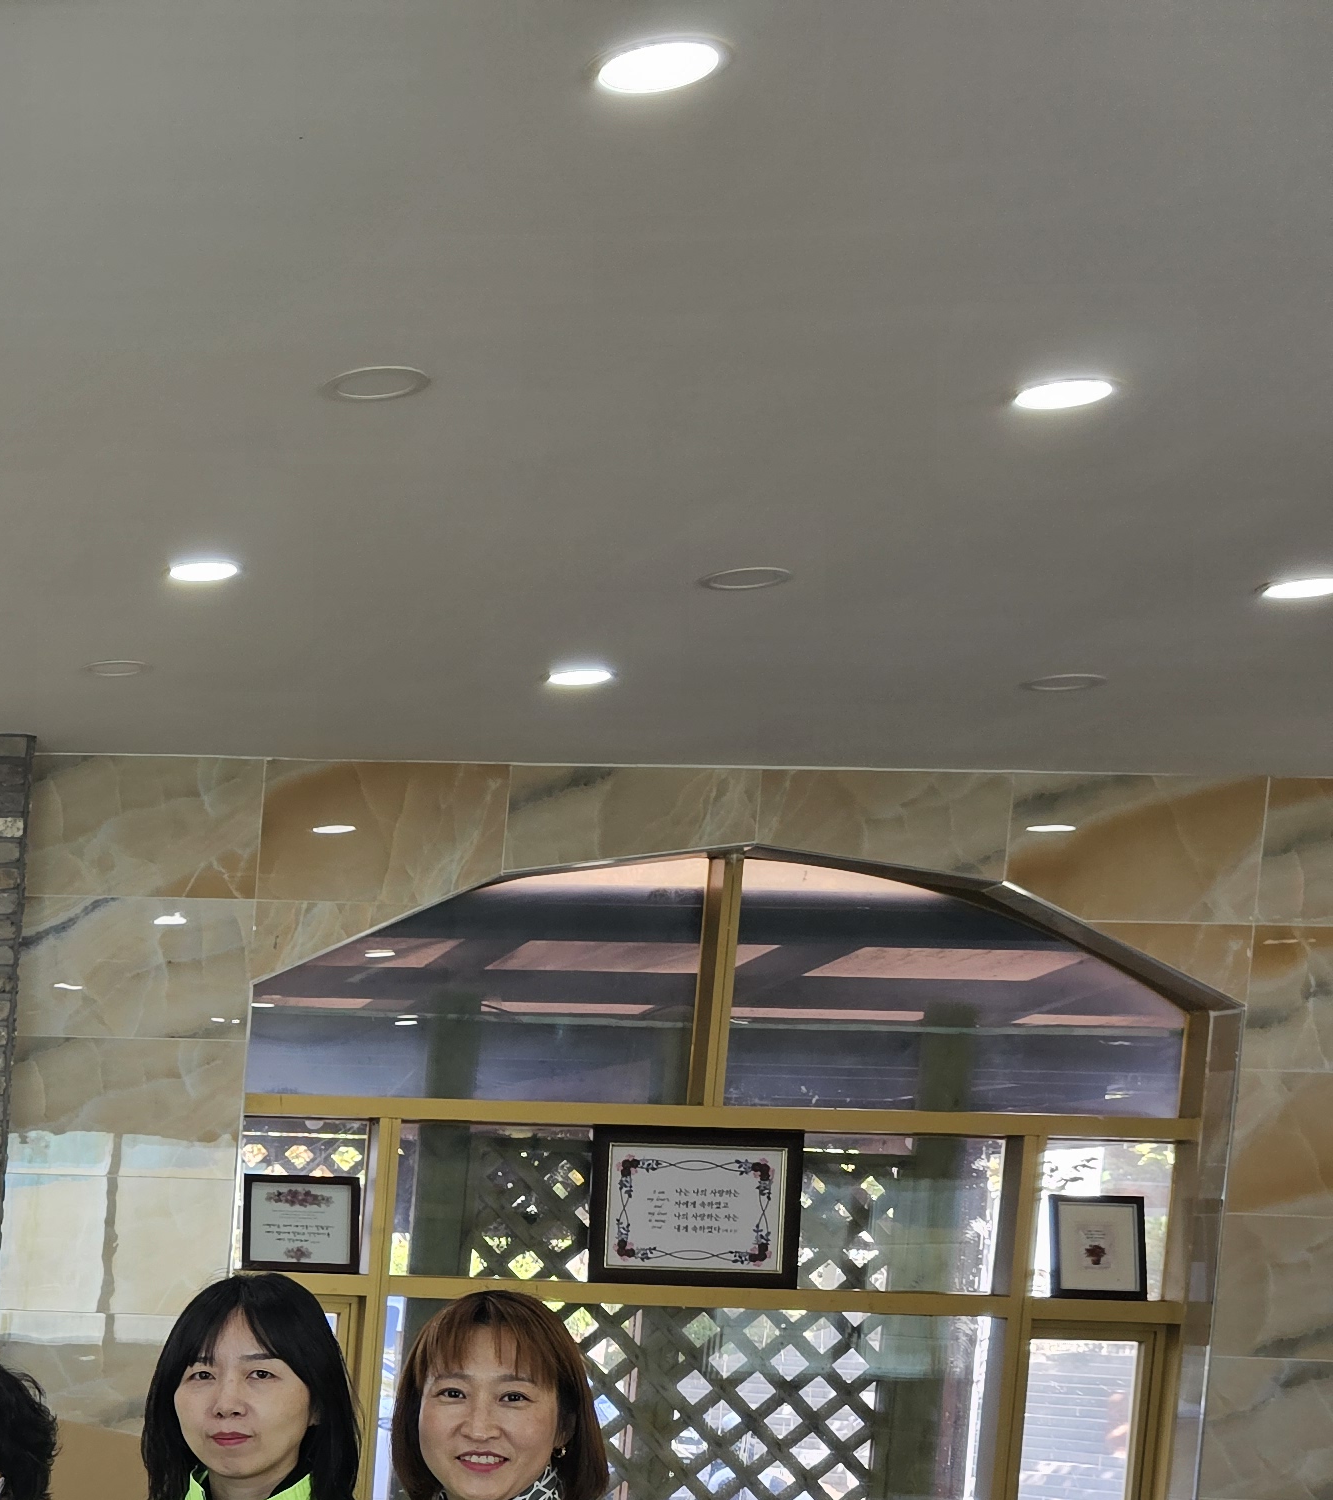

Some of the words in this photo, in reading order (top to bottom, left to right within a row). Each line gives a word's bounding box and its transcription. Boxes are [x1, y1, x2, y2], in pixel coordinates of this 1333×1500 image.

[675, 1187, 690, 1197] 나는
[709, 1188, 740, 1198] 사랑하는
[691, 1212, 721, 1222] 사랑하는
